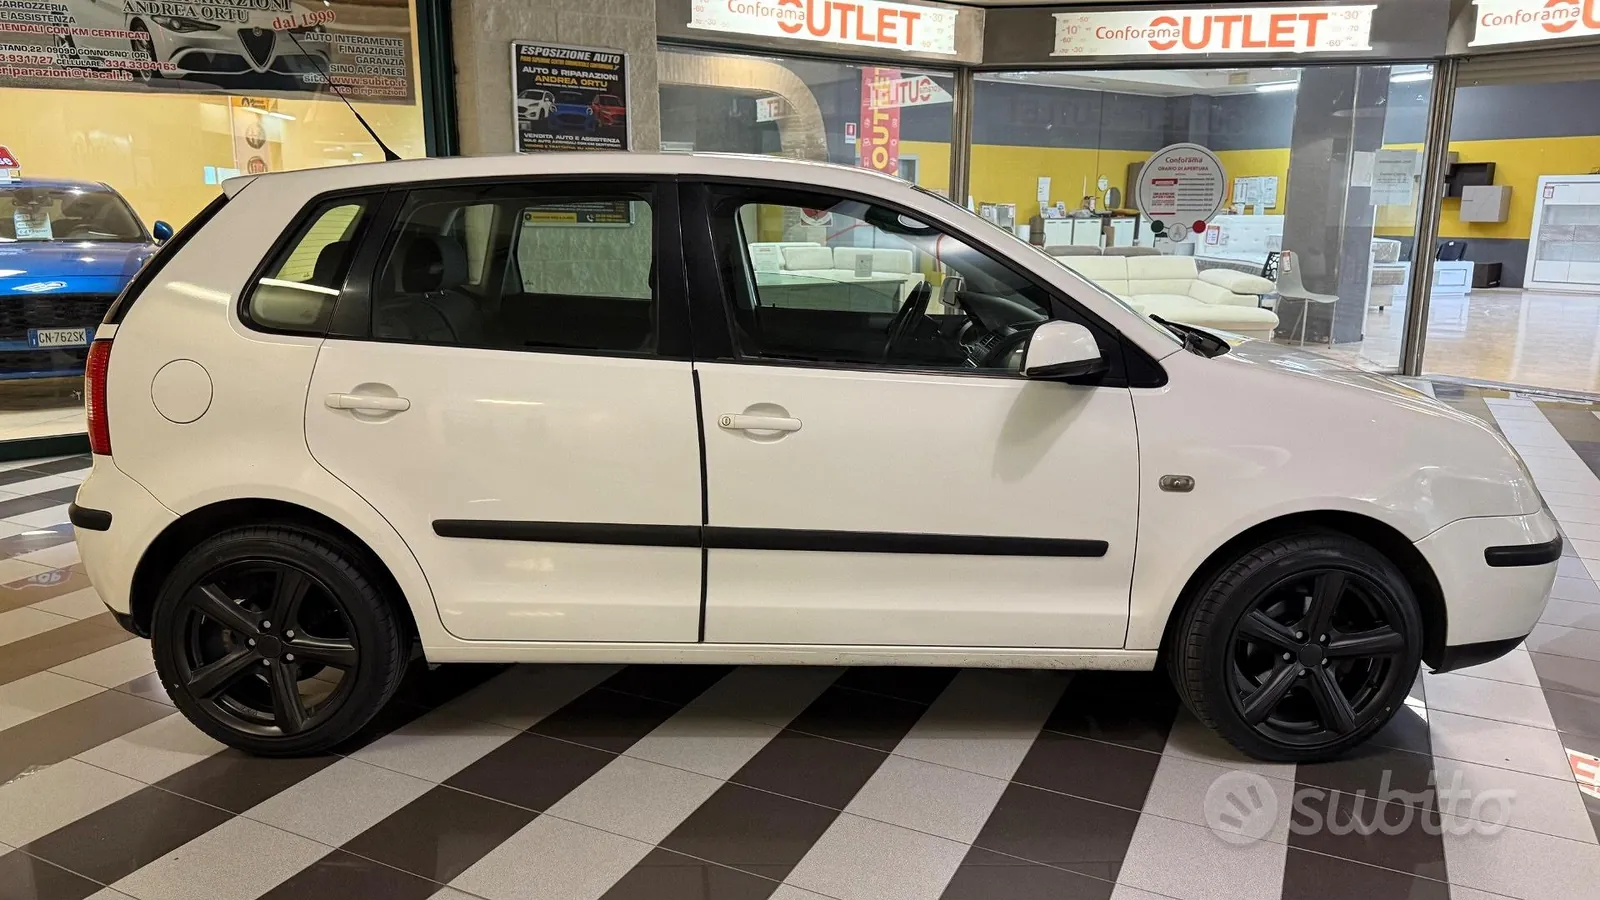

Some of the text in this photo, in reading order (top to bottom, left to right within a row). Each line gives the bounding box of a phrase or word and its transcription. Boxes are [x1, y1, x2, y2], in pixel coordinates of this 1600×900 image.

[11, 12, 76, 23] ASSISTENZA
[123, 1, 249, 22] ANDREA ORTU
[1481, 7, 1581, 26] Conforama
[272, 11, 336, 30] dal 1999
[728, 0, 921, 45] Conforama OUTLET
[0, 24, 149, 39] IENDALI CON KM CERTIFICATI
[1096, 13, 1329, 50] Conforama OUTLET
[305, 33, 404, 46] AUTO INTERAMENTE
[0, 44, 41, 53] TANO,22
[47, 47, 76, 55] 09090
[339, 45, 404, 56] FINANZIABILE
[520, 46, 591, 61] ESPOSIZIONE
[593, 53, 621, 64] AUTO
[105, 60, 177, 70] 334.3304163
[356, 56, 405, 66] GARANZIA
[0, 66, 133, 80] riparazioni@tiscali.it
[330, 65, 355, 73] SINO
[382, 68, 405, 76] MESI
[522, 66, 549, 75] AUTO
[560, 69, 619, 82] RIPARAZIONI
[331, 77, 407, 87] www.subito.it
[535, 75, 578, 85] ANDREA
[580, 79, 609, 88] ORTU
